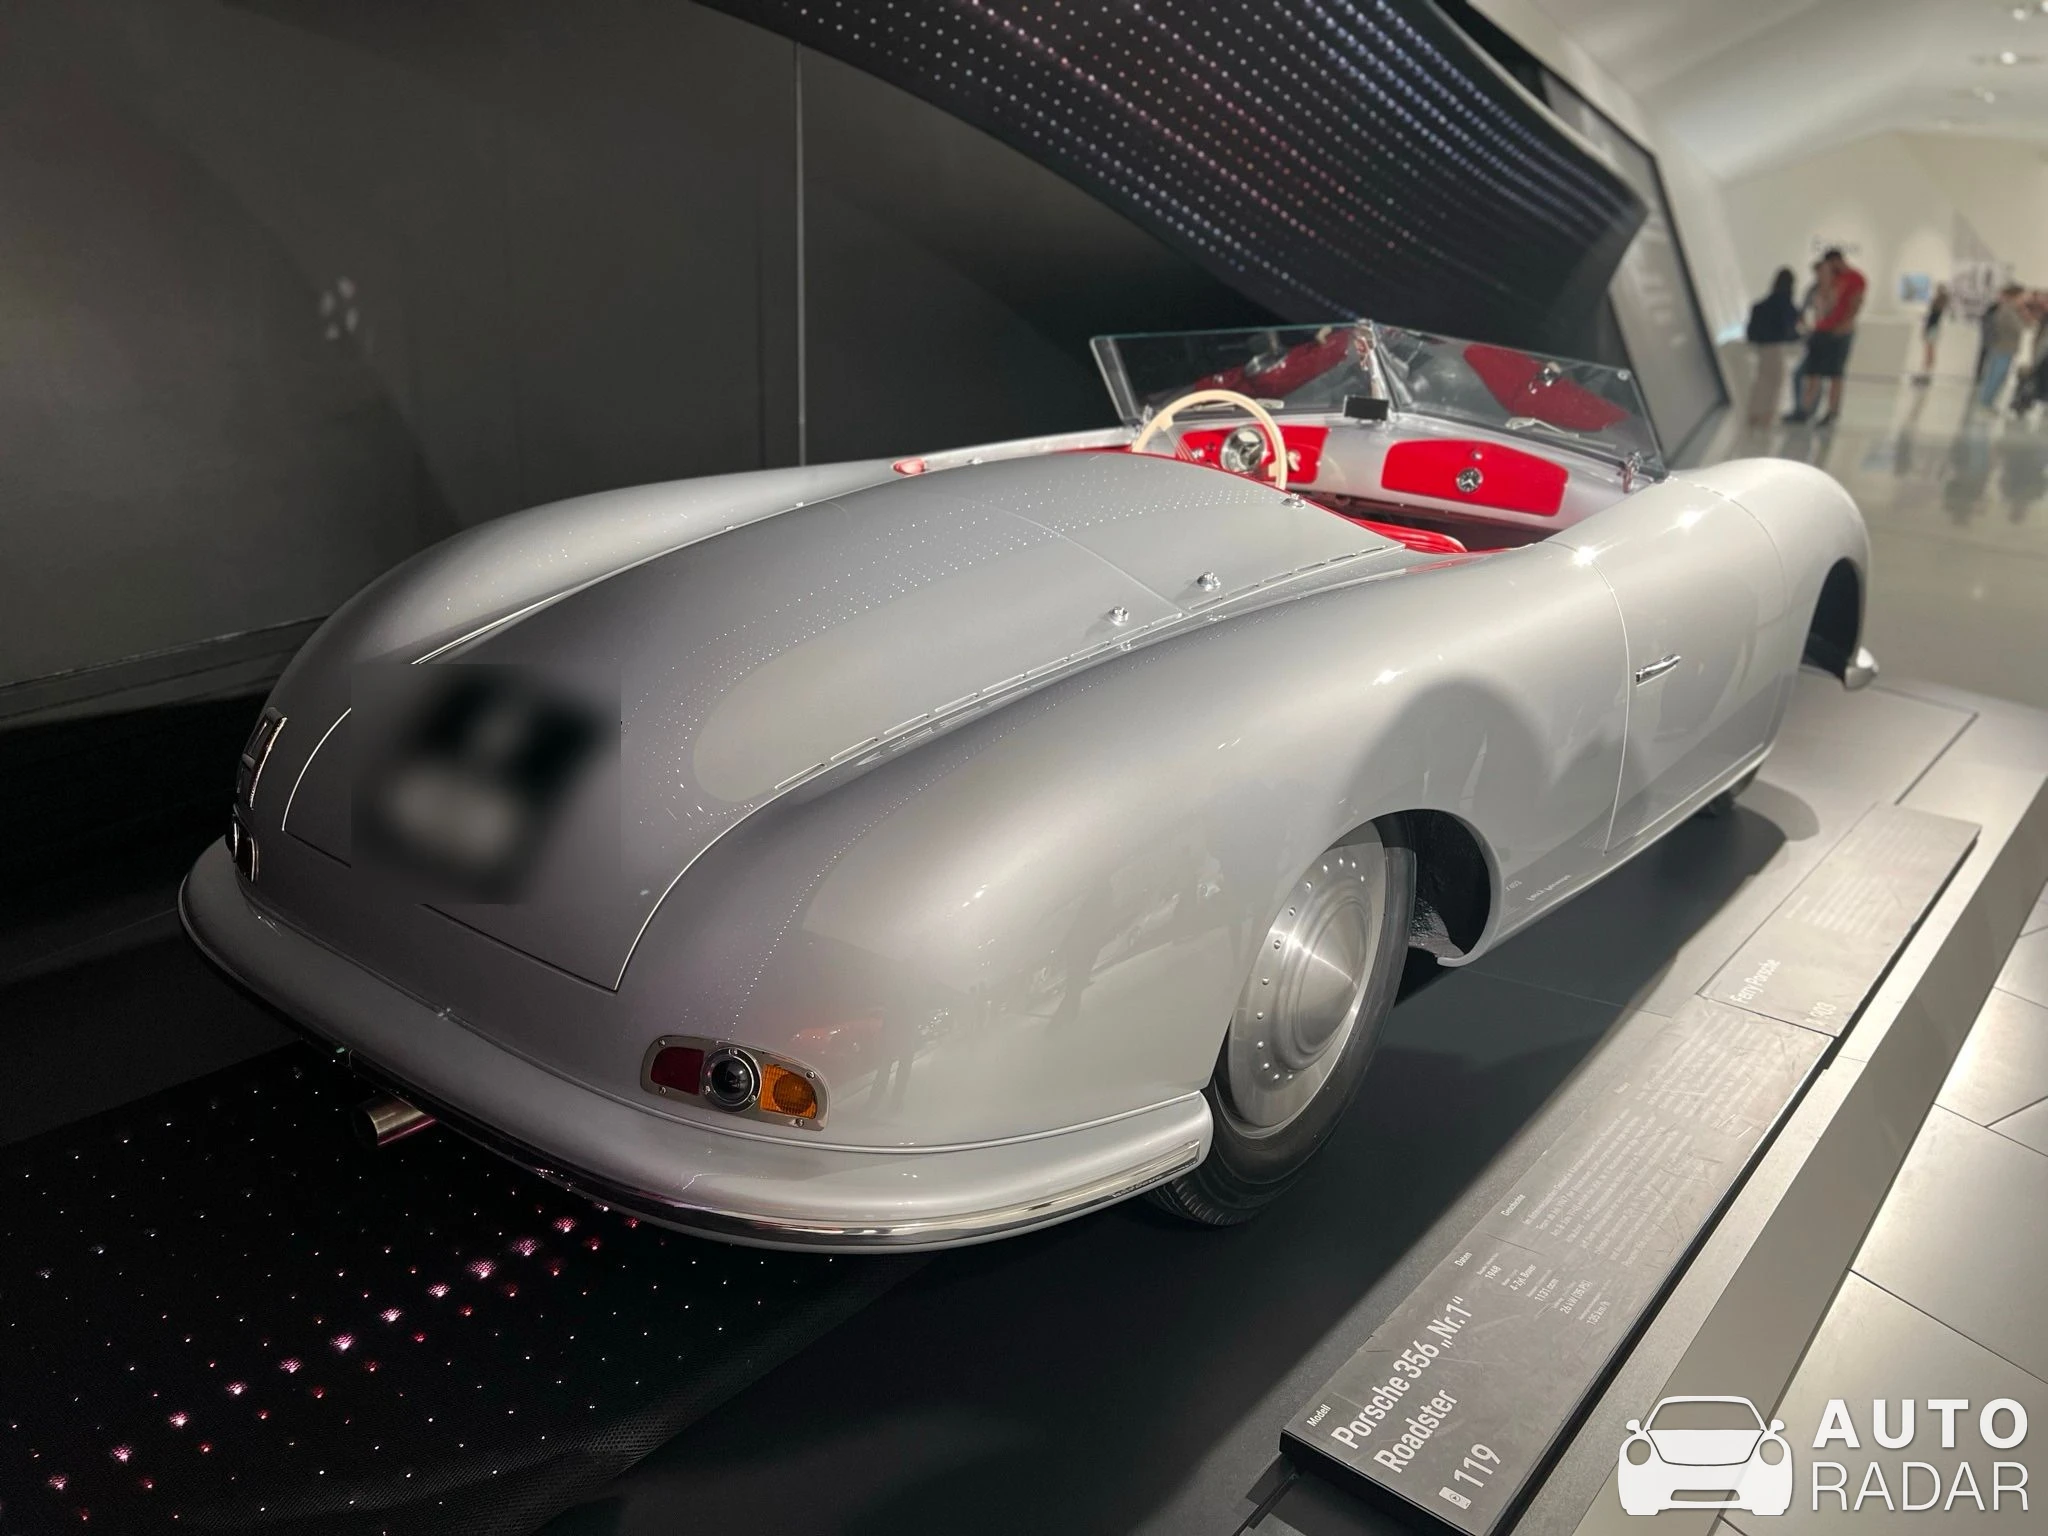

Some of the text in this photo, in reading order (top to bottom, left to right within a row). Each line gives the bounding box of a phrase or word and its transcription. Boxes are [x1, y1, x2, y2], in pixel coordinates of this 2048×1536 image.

[1744, 959, 1781, 987] Porsche
[1454, 1252, 1472, 1266] Daten
[1484, 1265, 1502, 1280] 1948
[1331, 1372, 1411, 1449] Porsche
[1394, 1340, 1440, 1380] 356
[1306, 1404, 1331, 1427] Modell
[1374, 1388, 1458, 1473] Roadster
[1454, 1443, 1501, 1488] 119
